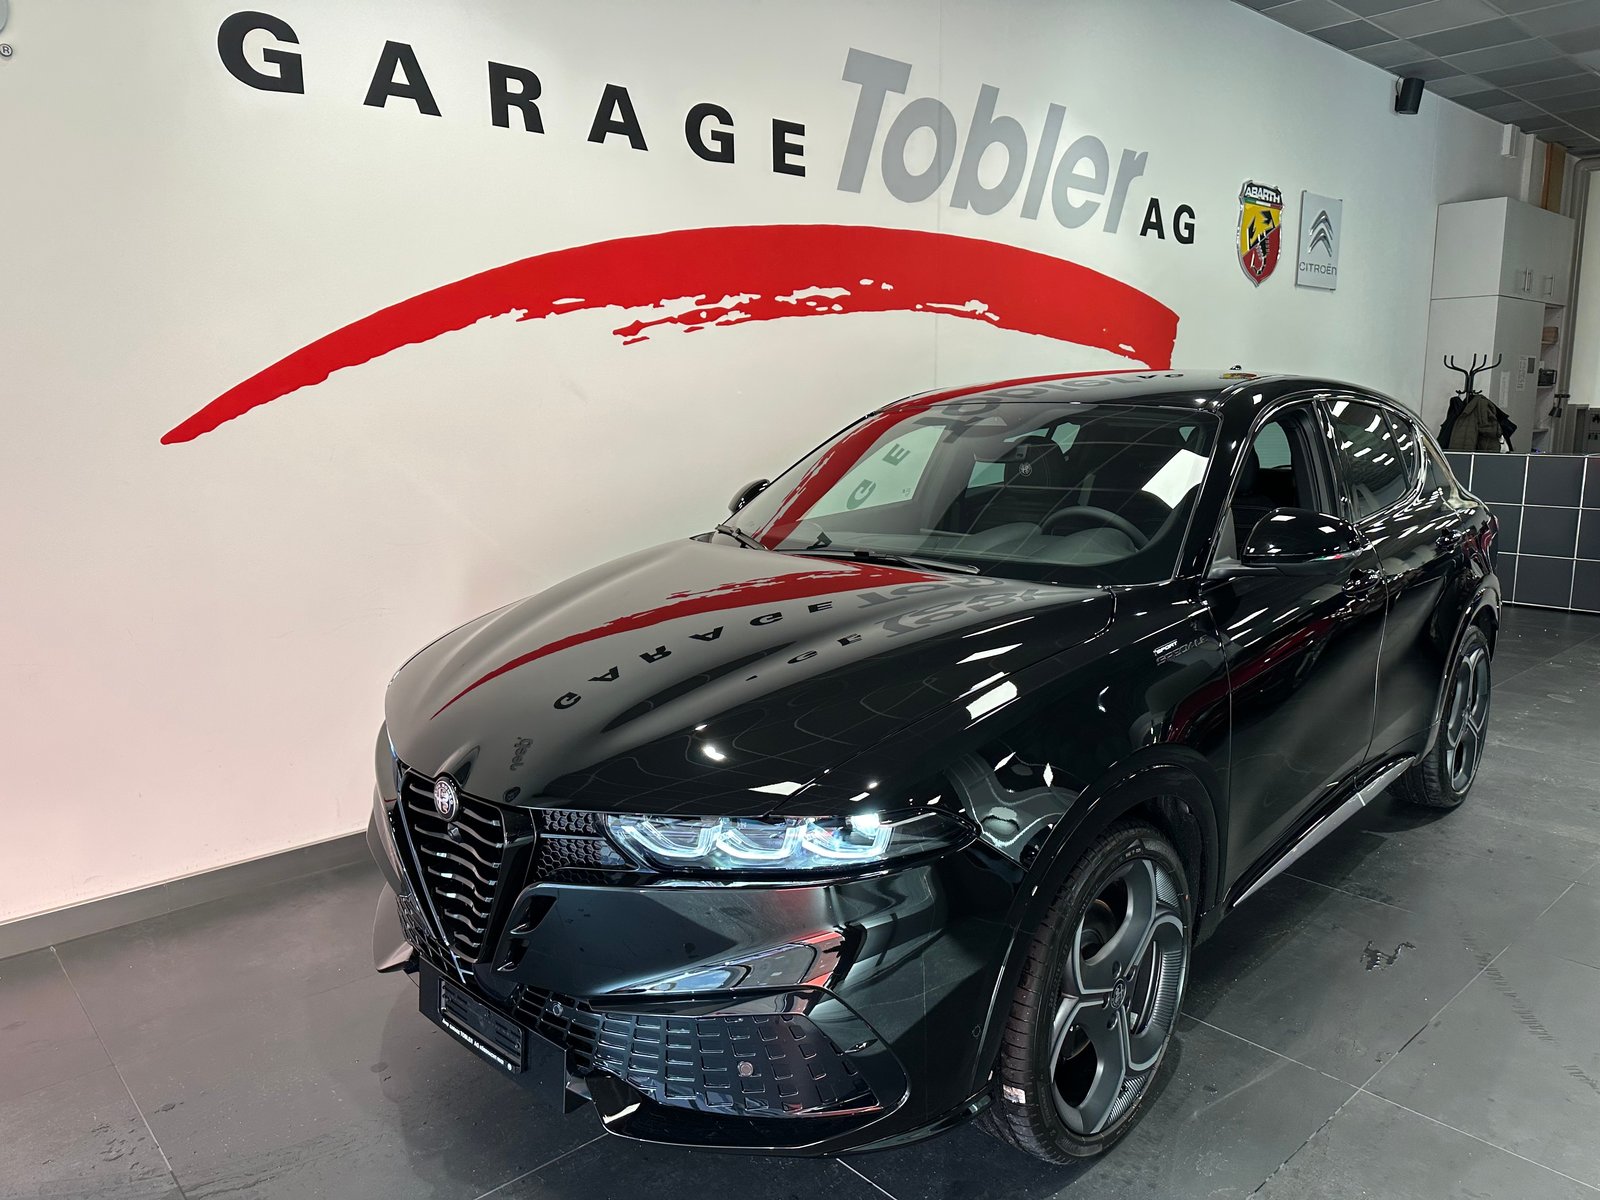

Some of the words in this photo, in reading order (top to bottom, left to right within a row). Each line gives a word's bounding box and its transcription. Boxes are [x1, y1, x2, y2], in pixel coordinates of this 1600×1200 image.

[218, 10, 806, 177] GARAGE
[837, 47, 1148, 234] Tobler
[1140, 197, 1196, 244] AG
[1245, 187, 1281, 204] ABARTH
